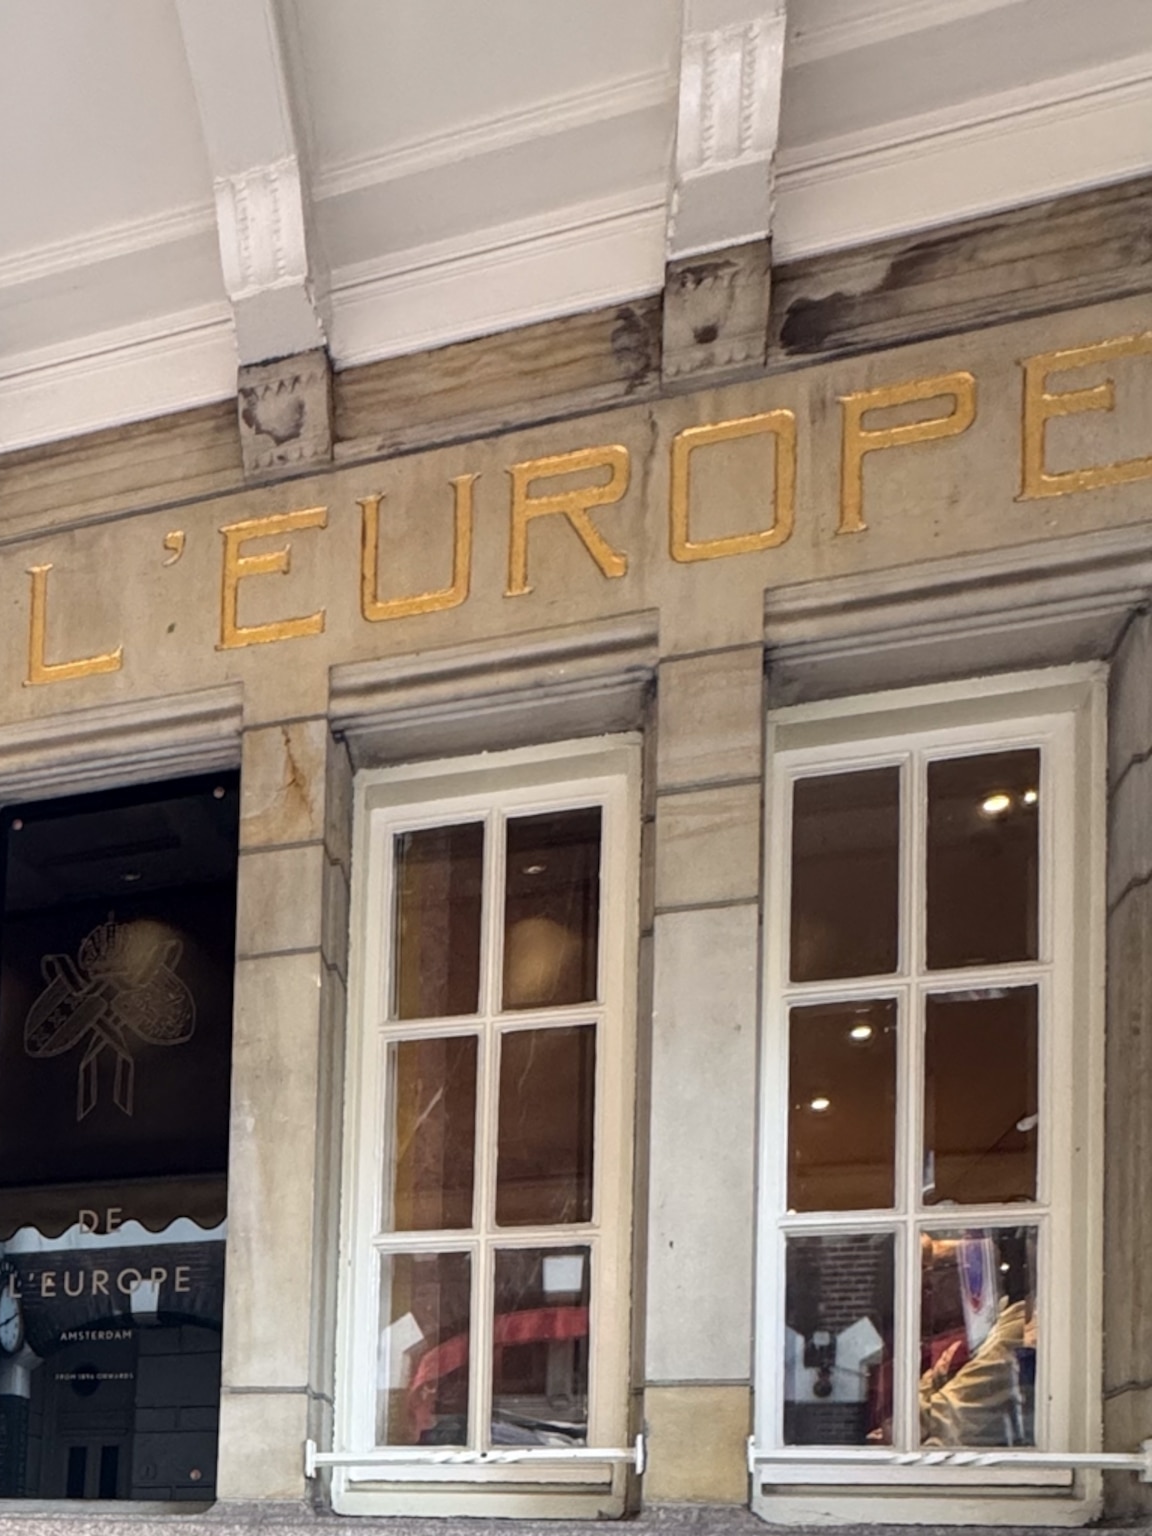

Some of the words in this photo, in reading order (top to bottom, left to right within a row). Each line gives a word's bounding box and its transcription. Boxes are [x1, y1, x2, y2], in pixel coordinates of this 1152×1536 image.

[21, 329, 1152, 688] L'EUROPE
[78, 1207, 123, 1235] DE
[9, 1265, 192, 1298] L'EUROPE
[59, 1329, 133, 1342] AMSTERDAM
